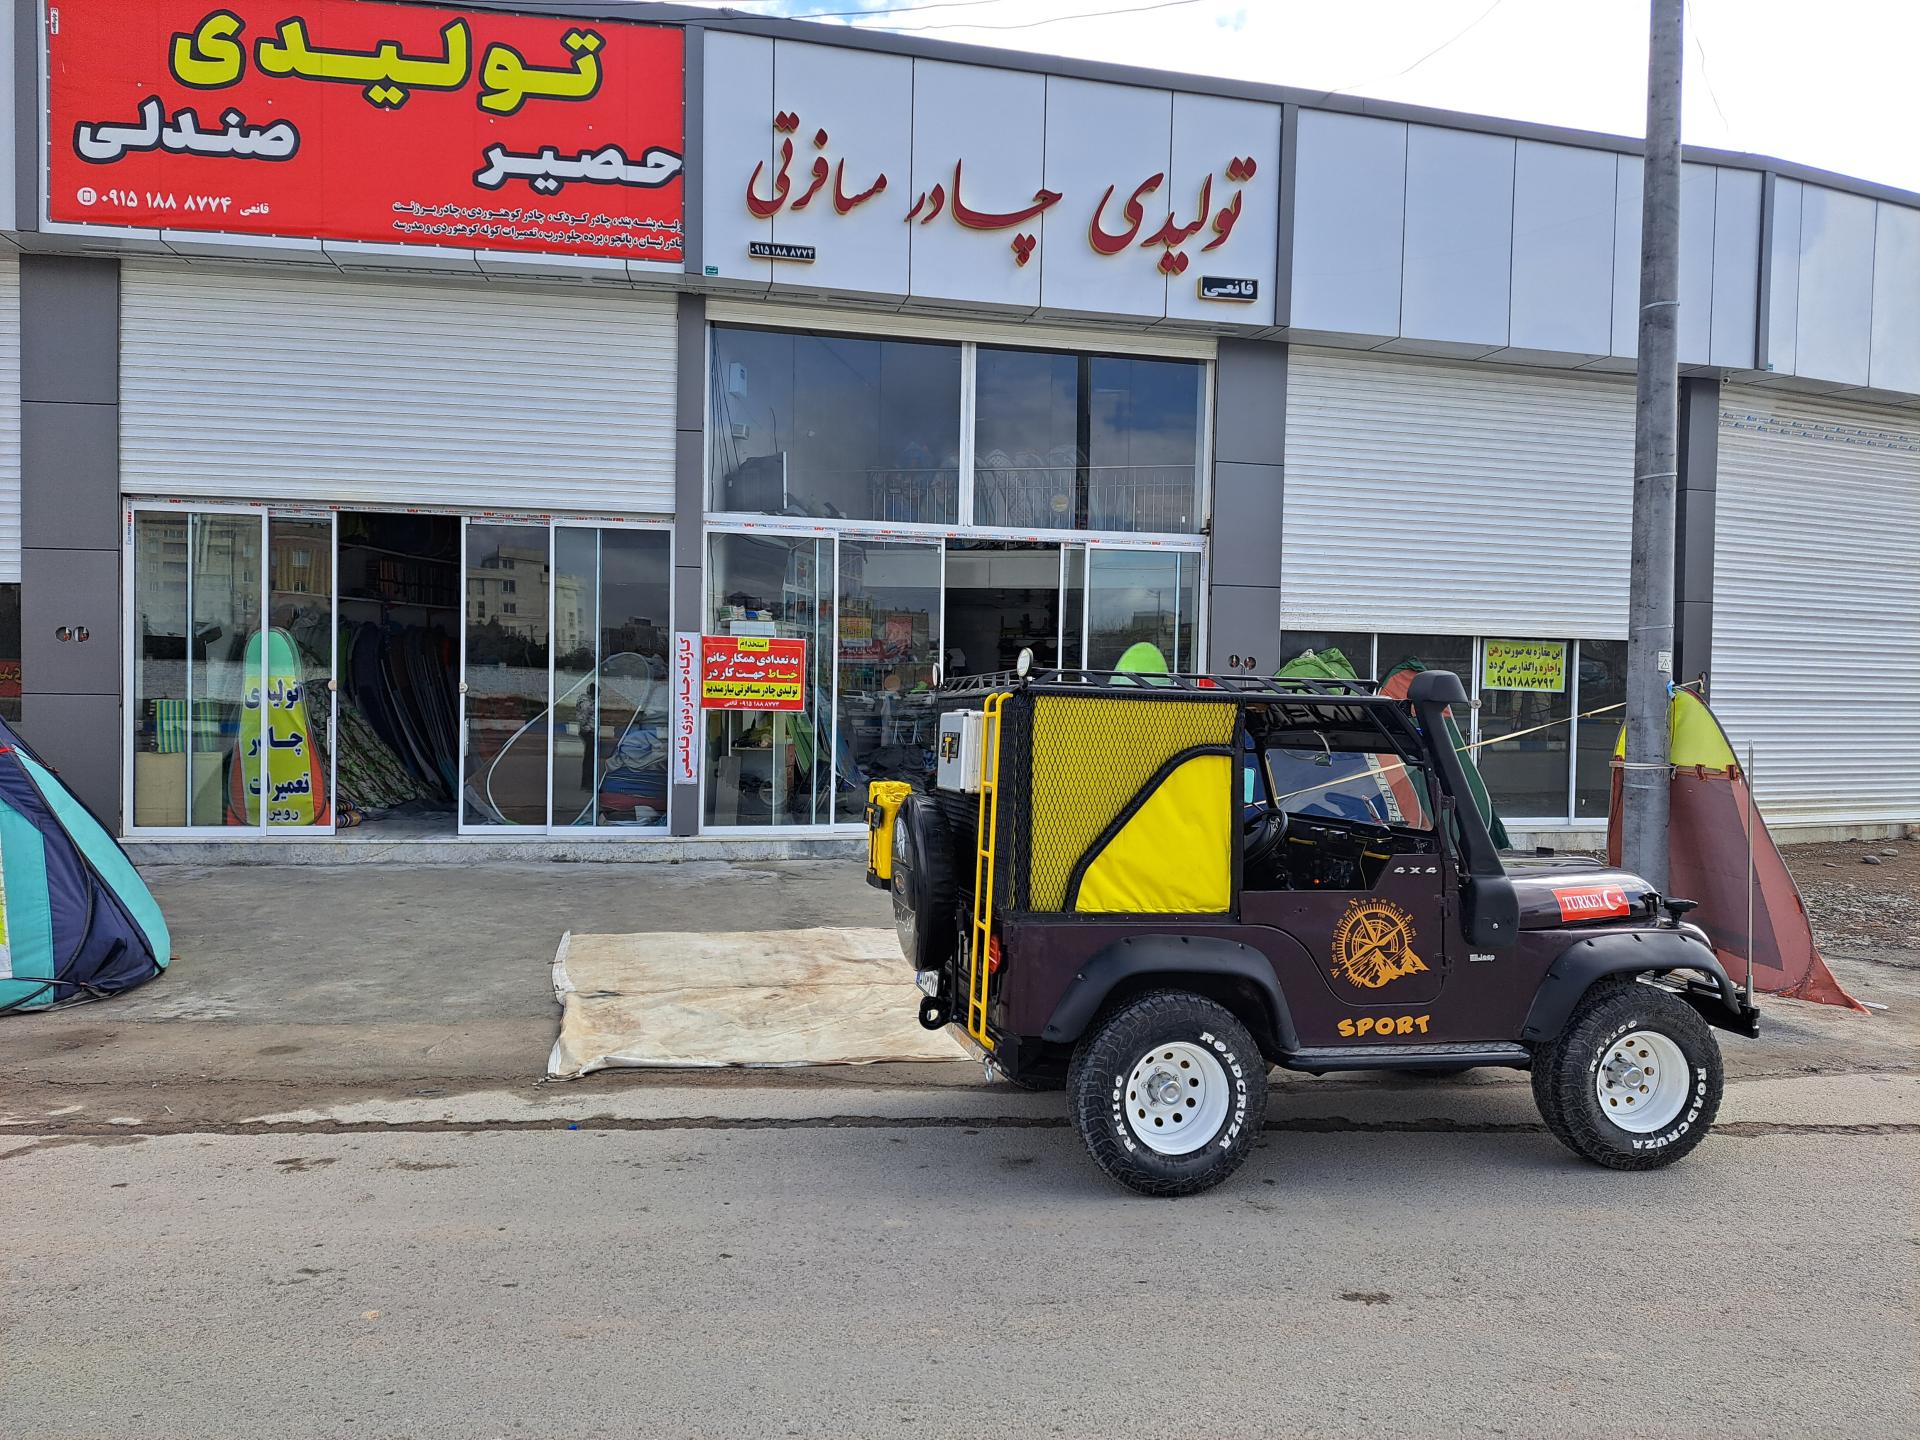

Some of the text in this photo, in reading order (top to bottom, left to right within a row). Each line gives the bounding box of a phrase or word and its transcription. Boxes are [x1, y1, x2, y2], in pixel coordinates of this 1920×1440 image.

[171, 11, 606, 115] تولیدی
[74, 97, 684, 191] حصیر صندلی
[101, 189, 270, 216] ۰۹۱۵ ۱۸۸ ۸۷۷۴ قانعی
[745, 110, 1257, 276] تولیدی چادر مسافرتی
[1203, 279, 1256, 299] قانعی
[706, 651, 799, 667] به تعدادی همکار خانم
[707, 668, 718, 680] در
[719, 667, 735, 680] کار
[735, 669, 766, 681] جهت
[1562, 894, 1603, 911] TURKEY
[1337, 1015, 1430, 1037] SPORT
[1200, 1031, 1246, 1150] ROADCRUZA
[1632, 1067, 1707, 1150] ROADCRUZA
